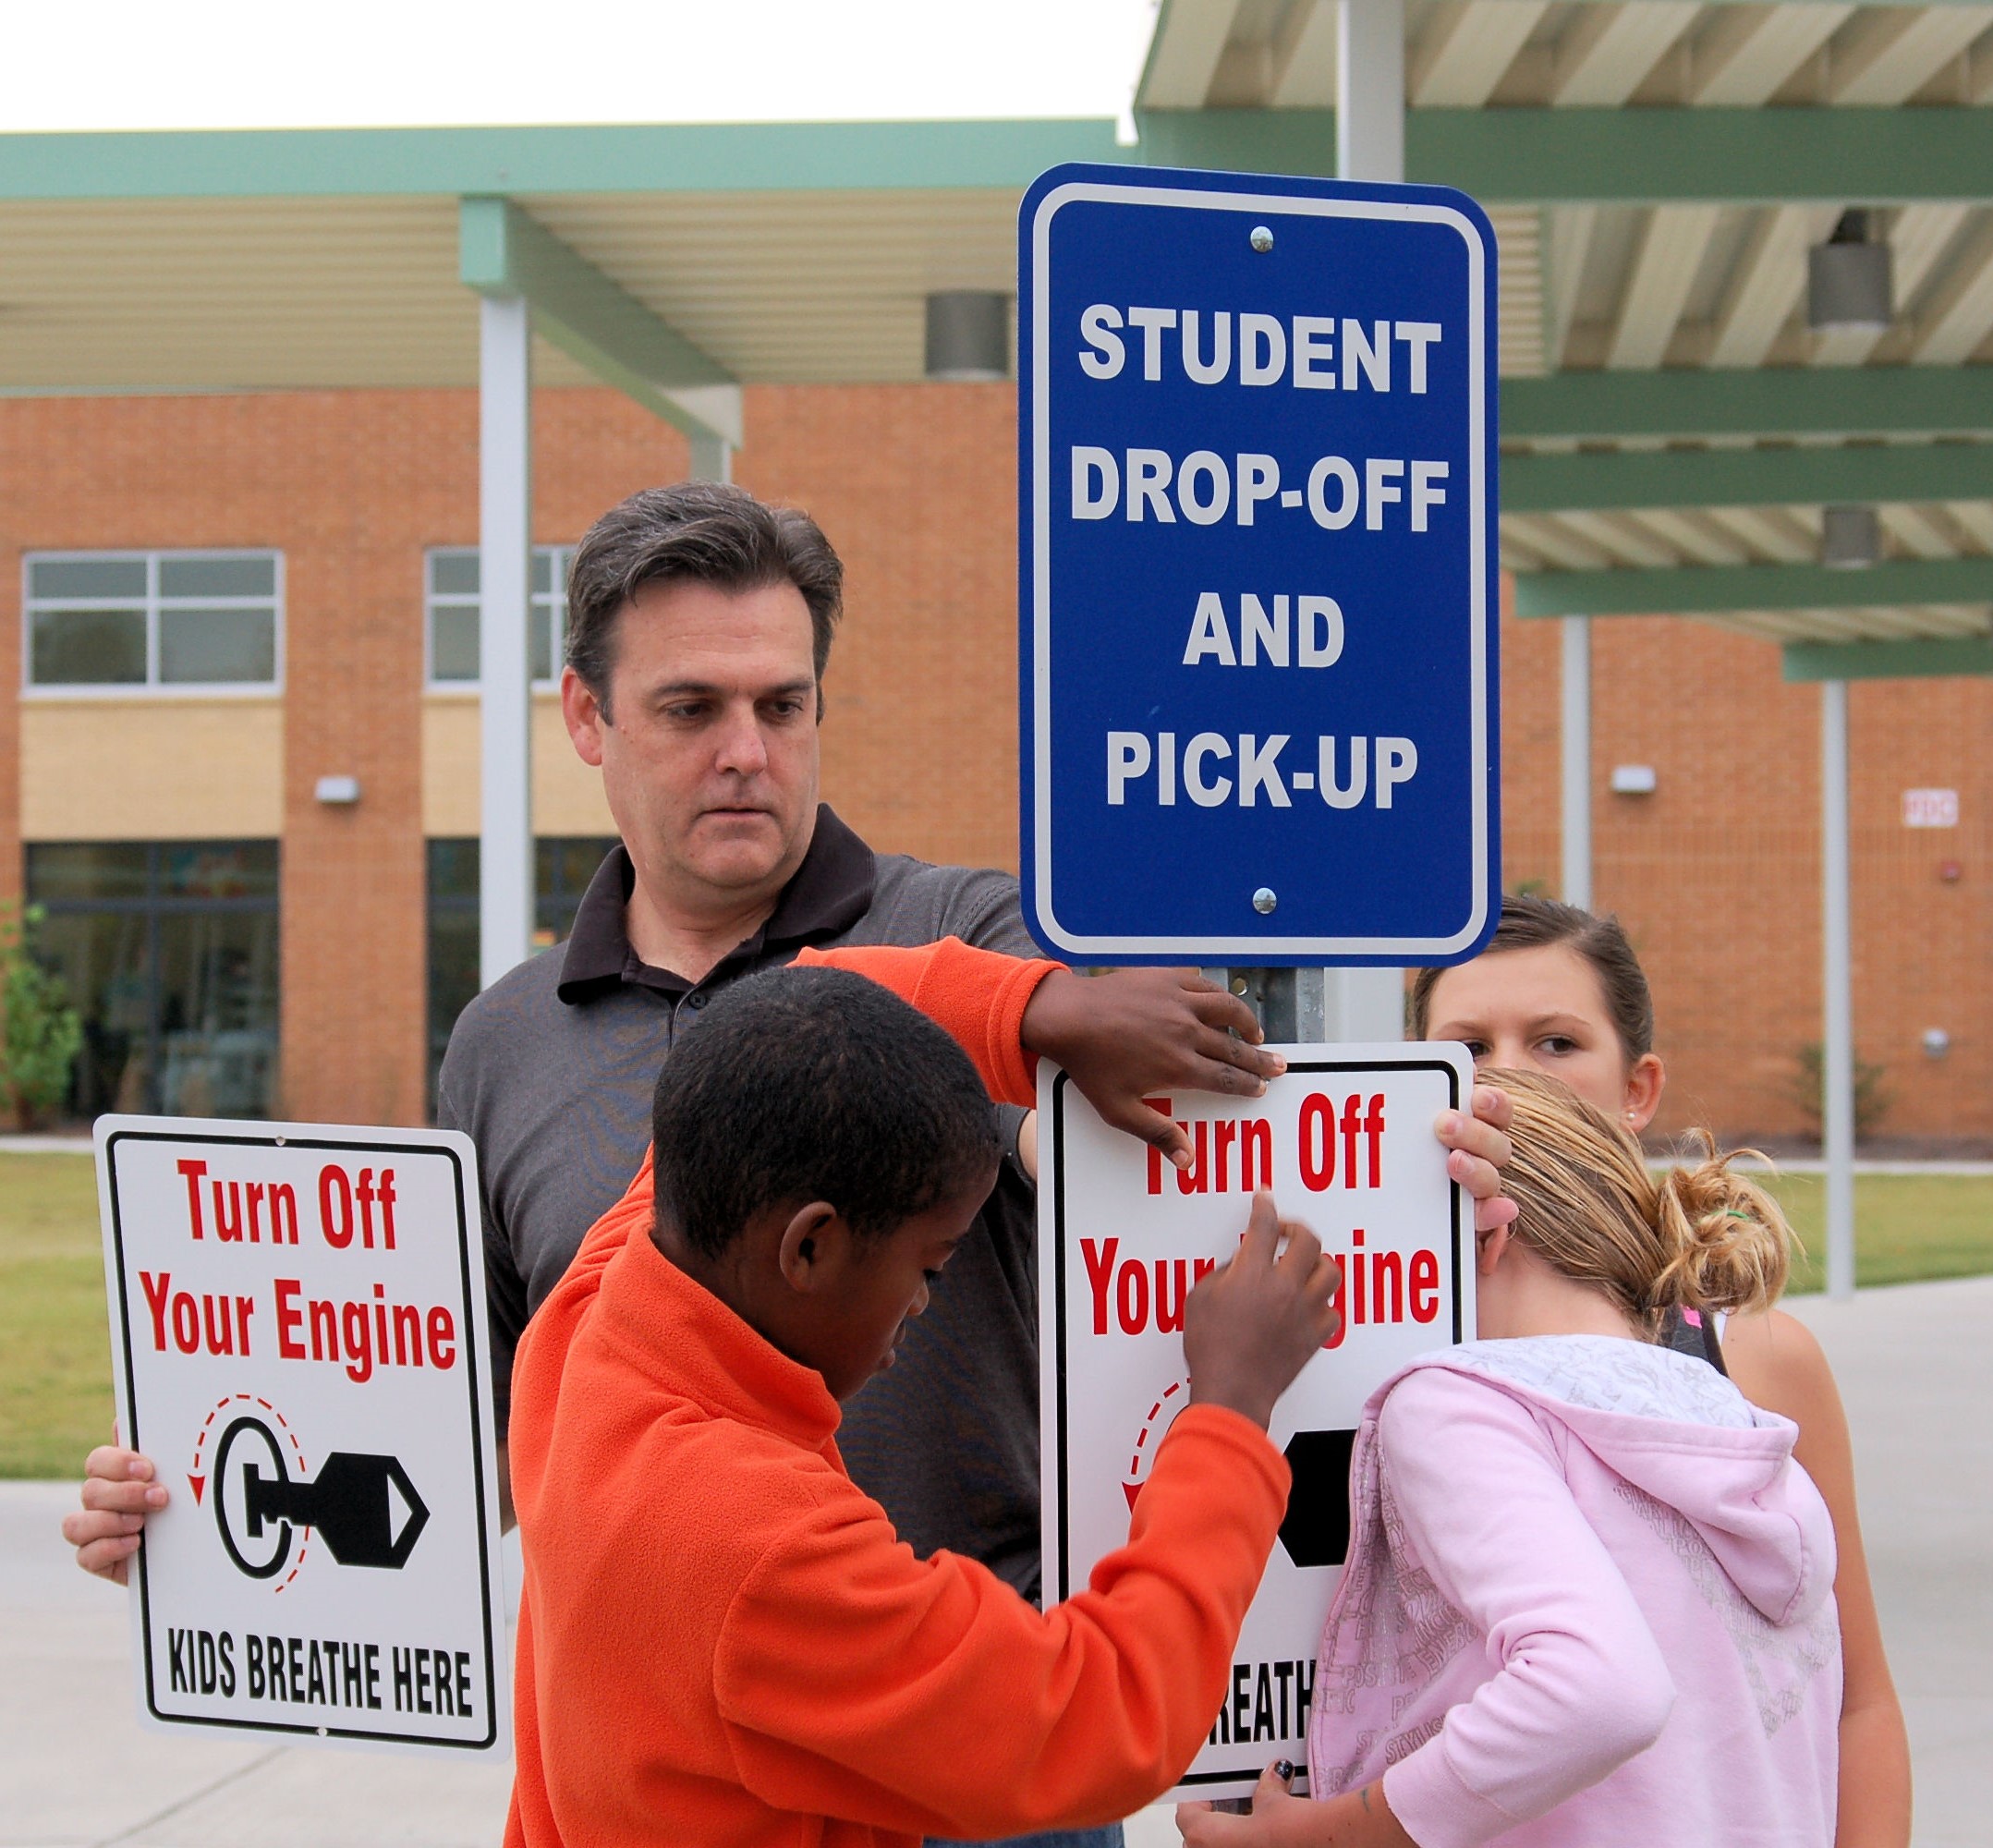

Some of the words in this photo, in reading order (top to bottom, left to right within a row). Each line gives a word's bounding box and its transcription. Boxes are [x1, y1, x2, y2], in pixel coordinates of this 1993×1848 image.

[1078, 303, 1442, 395] STUDENT
[1071, 445, 1450, 533] DROP-OFF
[1182, 591, 1344, 668] AND
[1107, 731, 1418, 810] PICK-UP
[1298, 1092, 1386, 1193] Off
[177, 1159, 300, 1246] Turn
[319, 1163, 397, 1250] Off
[140, 1270, 255, 1356] Your
[274, 1278, 456, 1384] Engine
[167, 1627, 236, 1698] KIDS
[246, 1634, 383, 1711] BREATHE
[392, 1646, 474, 1719] HERE
